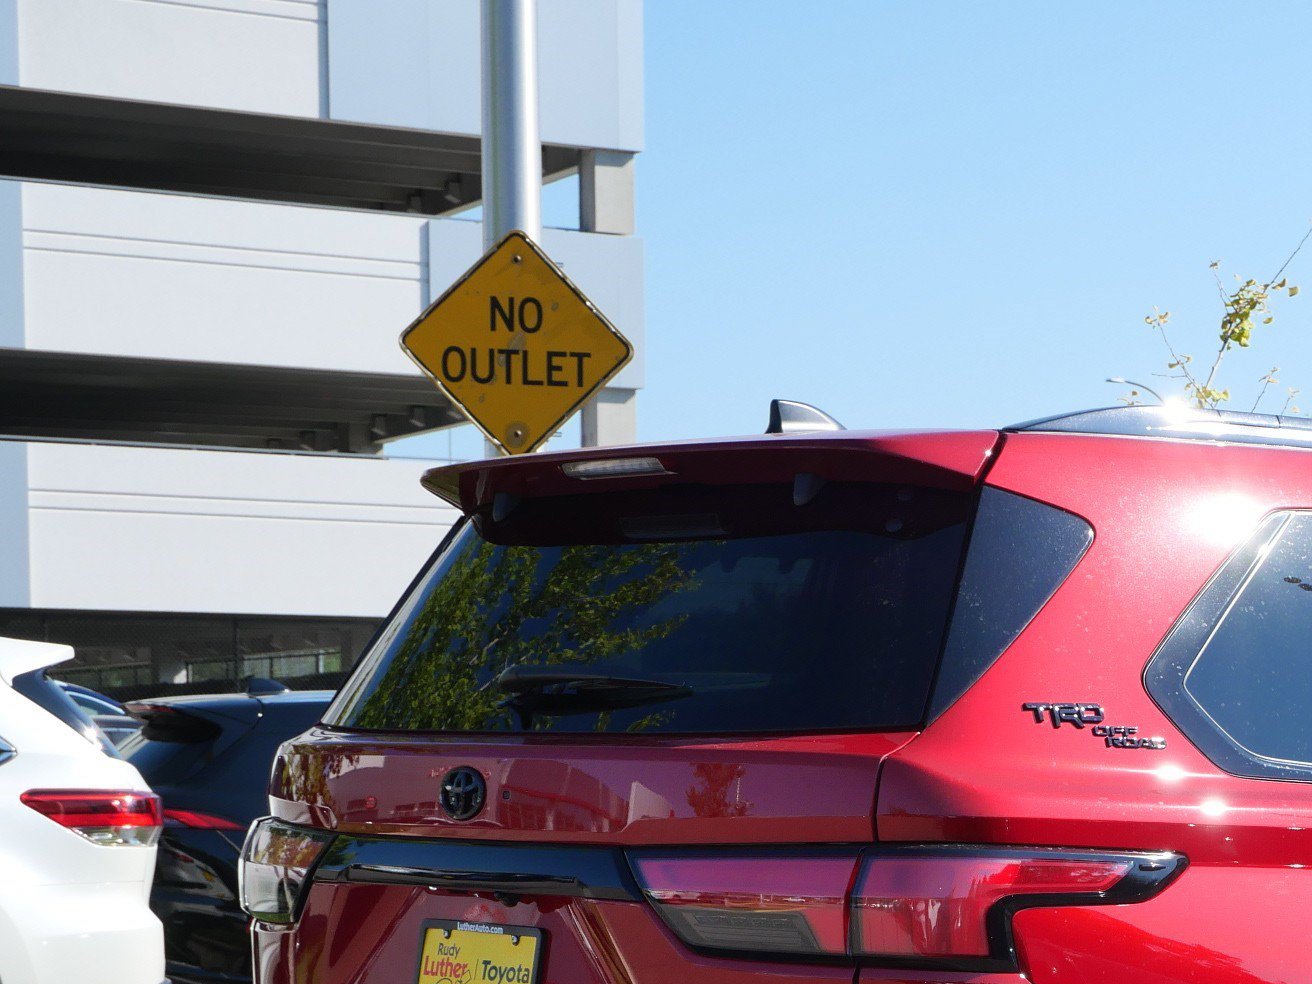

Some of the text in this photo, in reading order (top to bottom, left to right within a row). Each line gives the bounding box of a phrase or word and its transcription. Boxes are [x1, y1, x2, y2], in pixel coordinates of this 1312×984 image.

[489, 296, 544, 333] NO
[441, 346, 591, 387] OUTLET
[1022, 702, 1105, 728] TRD
[1092, 725, 1139, 737] OFF
[1105, 736, 1167, 749] ROAD
[457, 921, 504, 935] LutherAuto.com
[437, 942, 461, 959] Rudy
[423, 955, 468, 979] Luther
